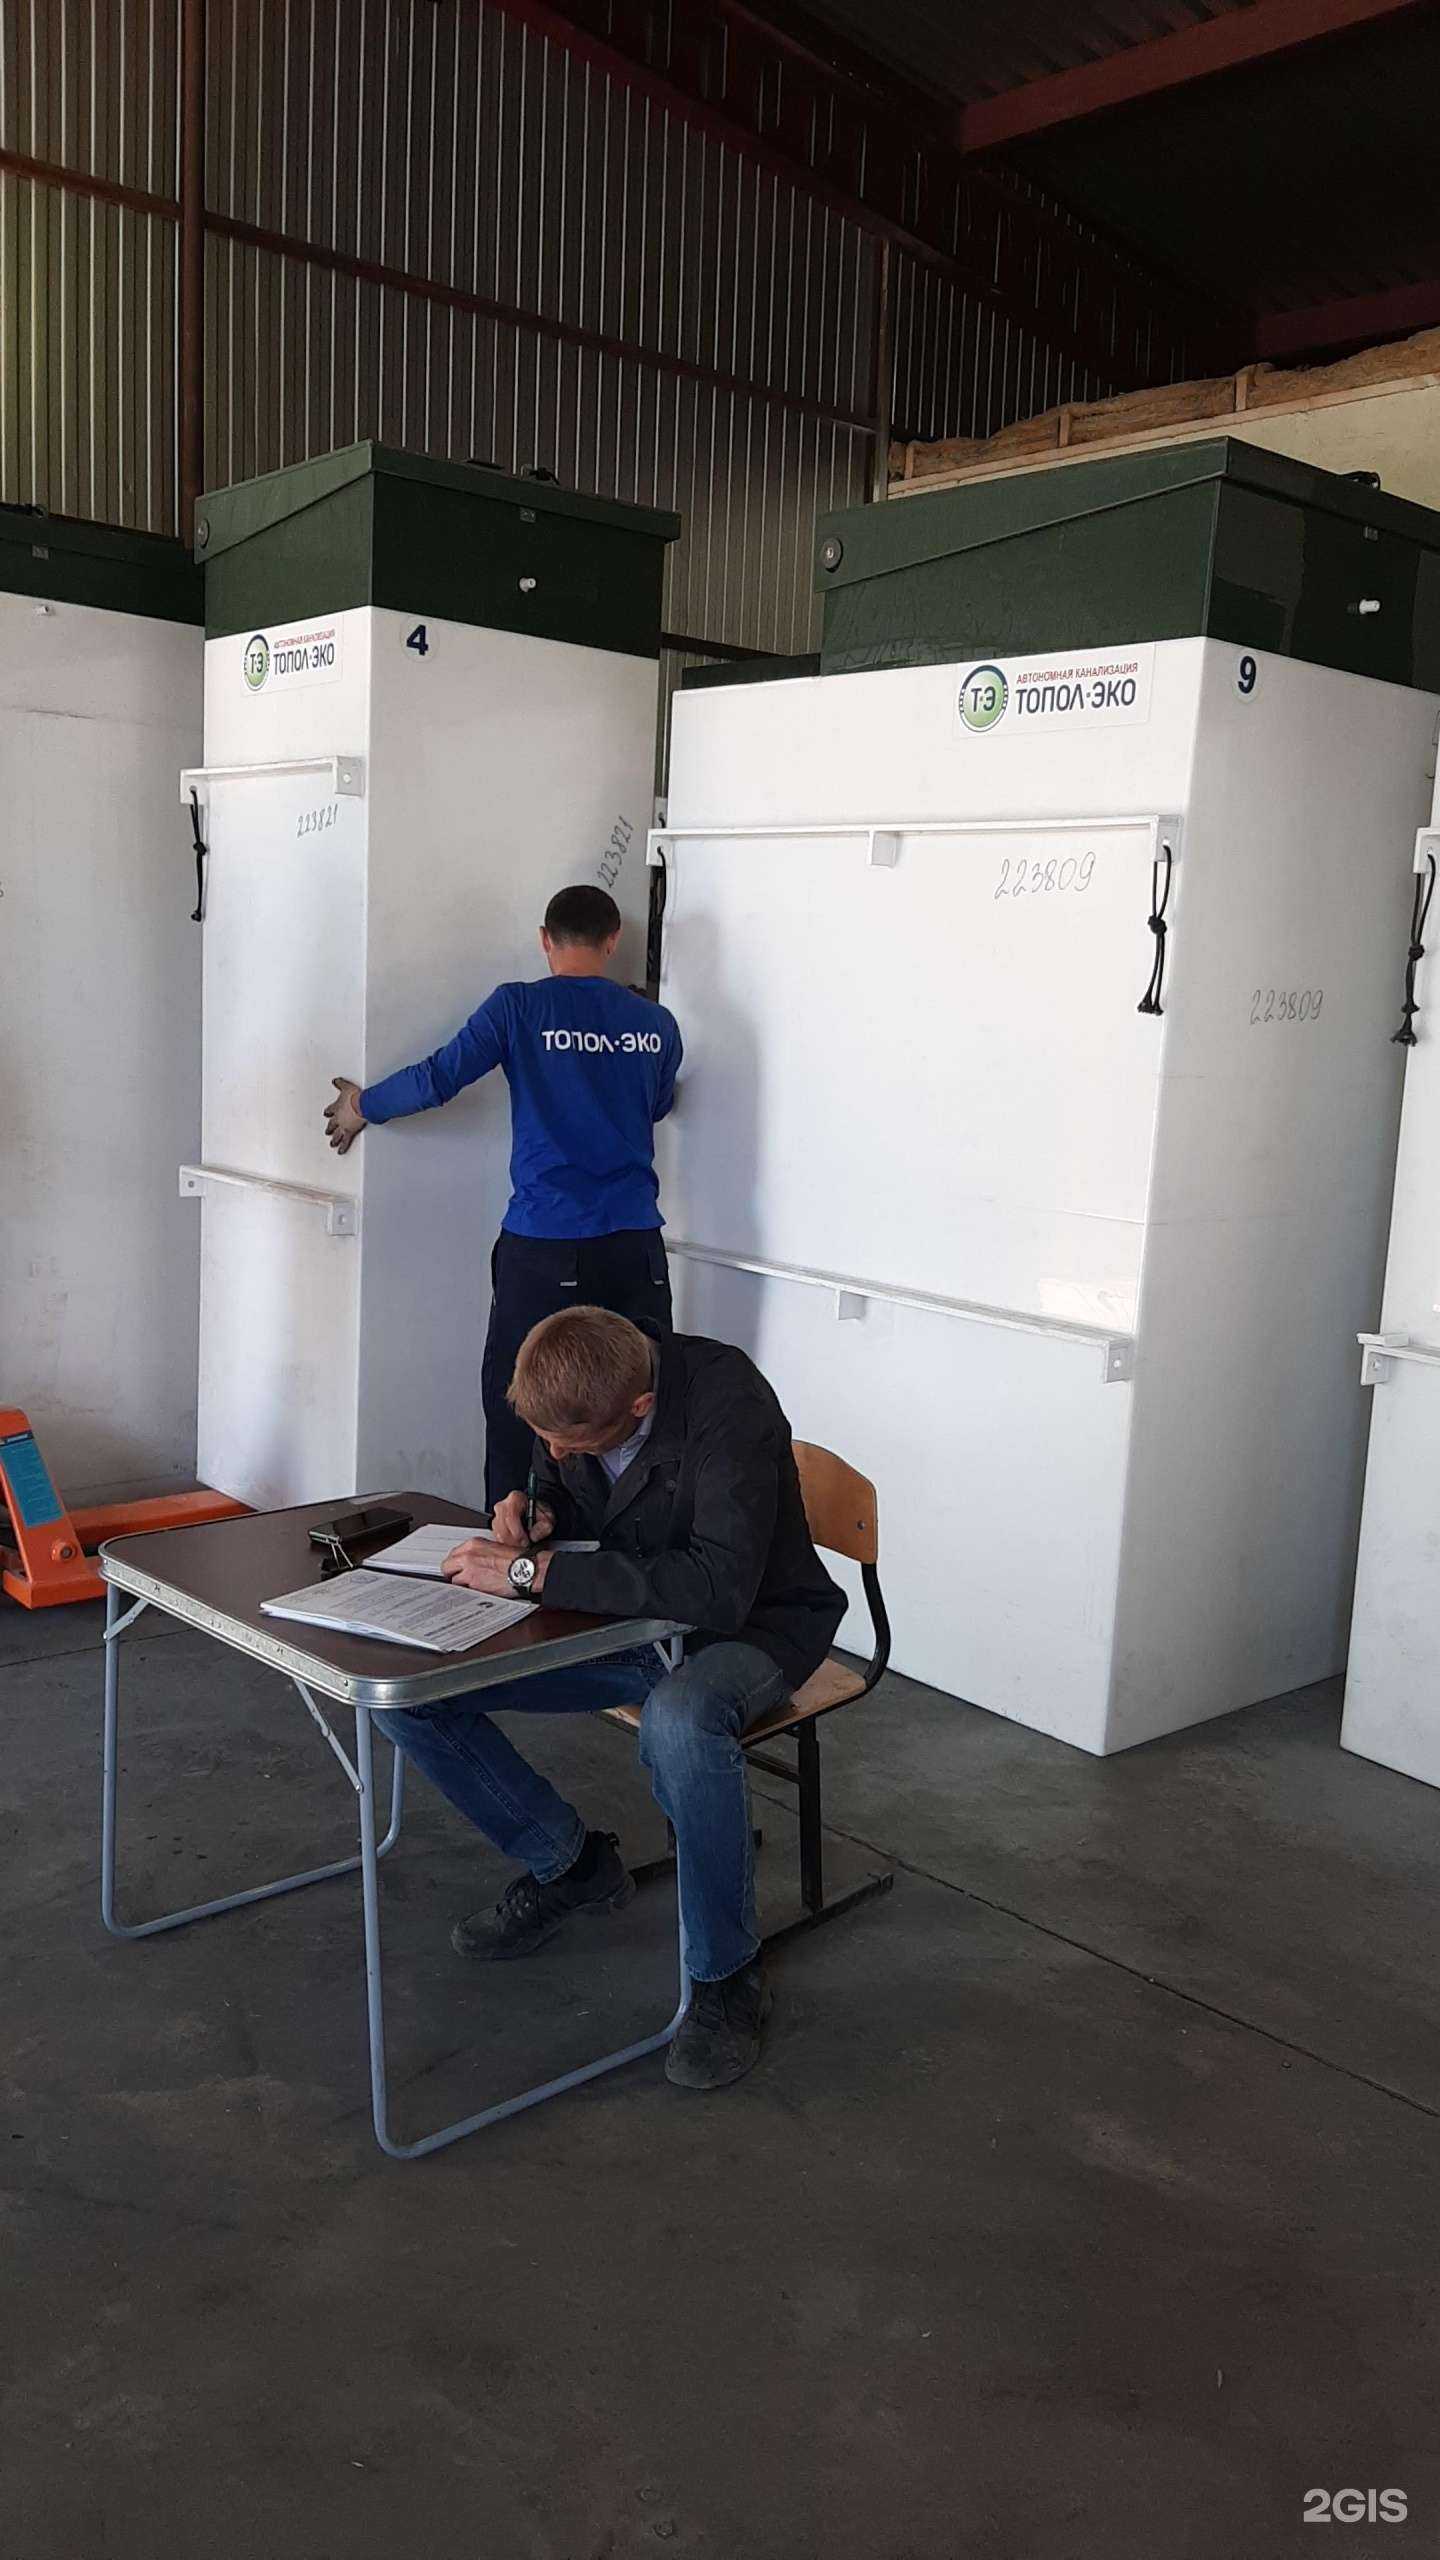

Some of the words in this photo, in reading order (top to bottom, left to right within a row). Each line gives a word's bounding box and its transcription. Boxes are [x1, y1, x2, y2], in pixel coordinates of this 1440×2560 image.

[406, 624, 429, 656] 4
[1016, 670, 1074, 685] АВТОНОМНАЯ
[1075, 662, 1138, 679] КАНАЛИЗАЦИЯ
[1238, 655, 1256, 694] 9
[297, 803, 338, 838] 223821
[597, 815, 634, 889] 223821
[994, 851, 1096, 900] 223809
[1249, 989, 1323, 1024] 223809
